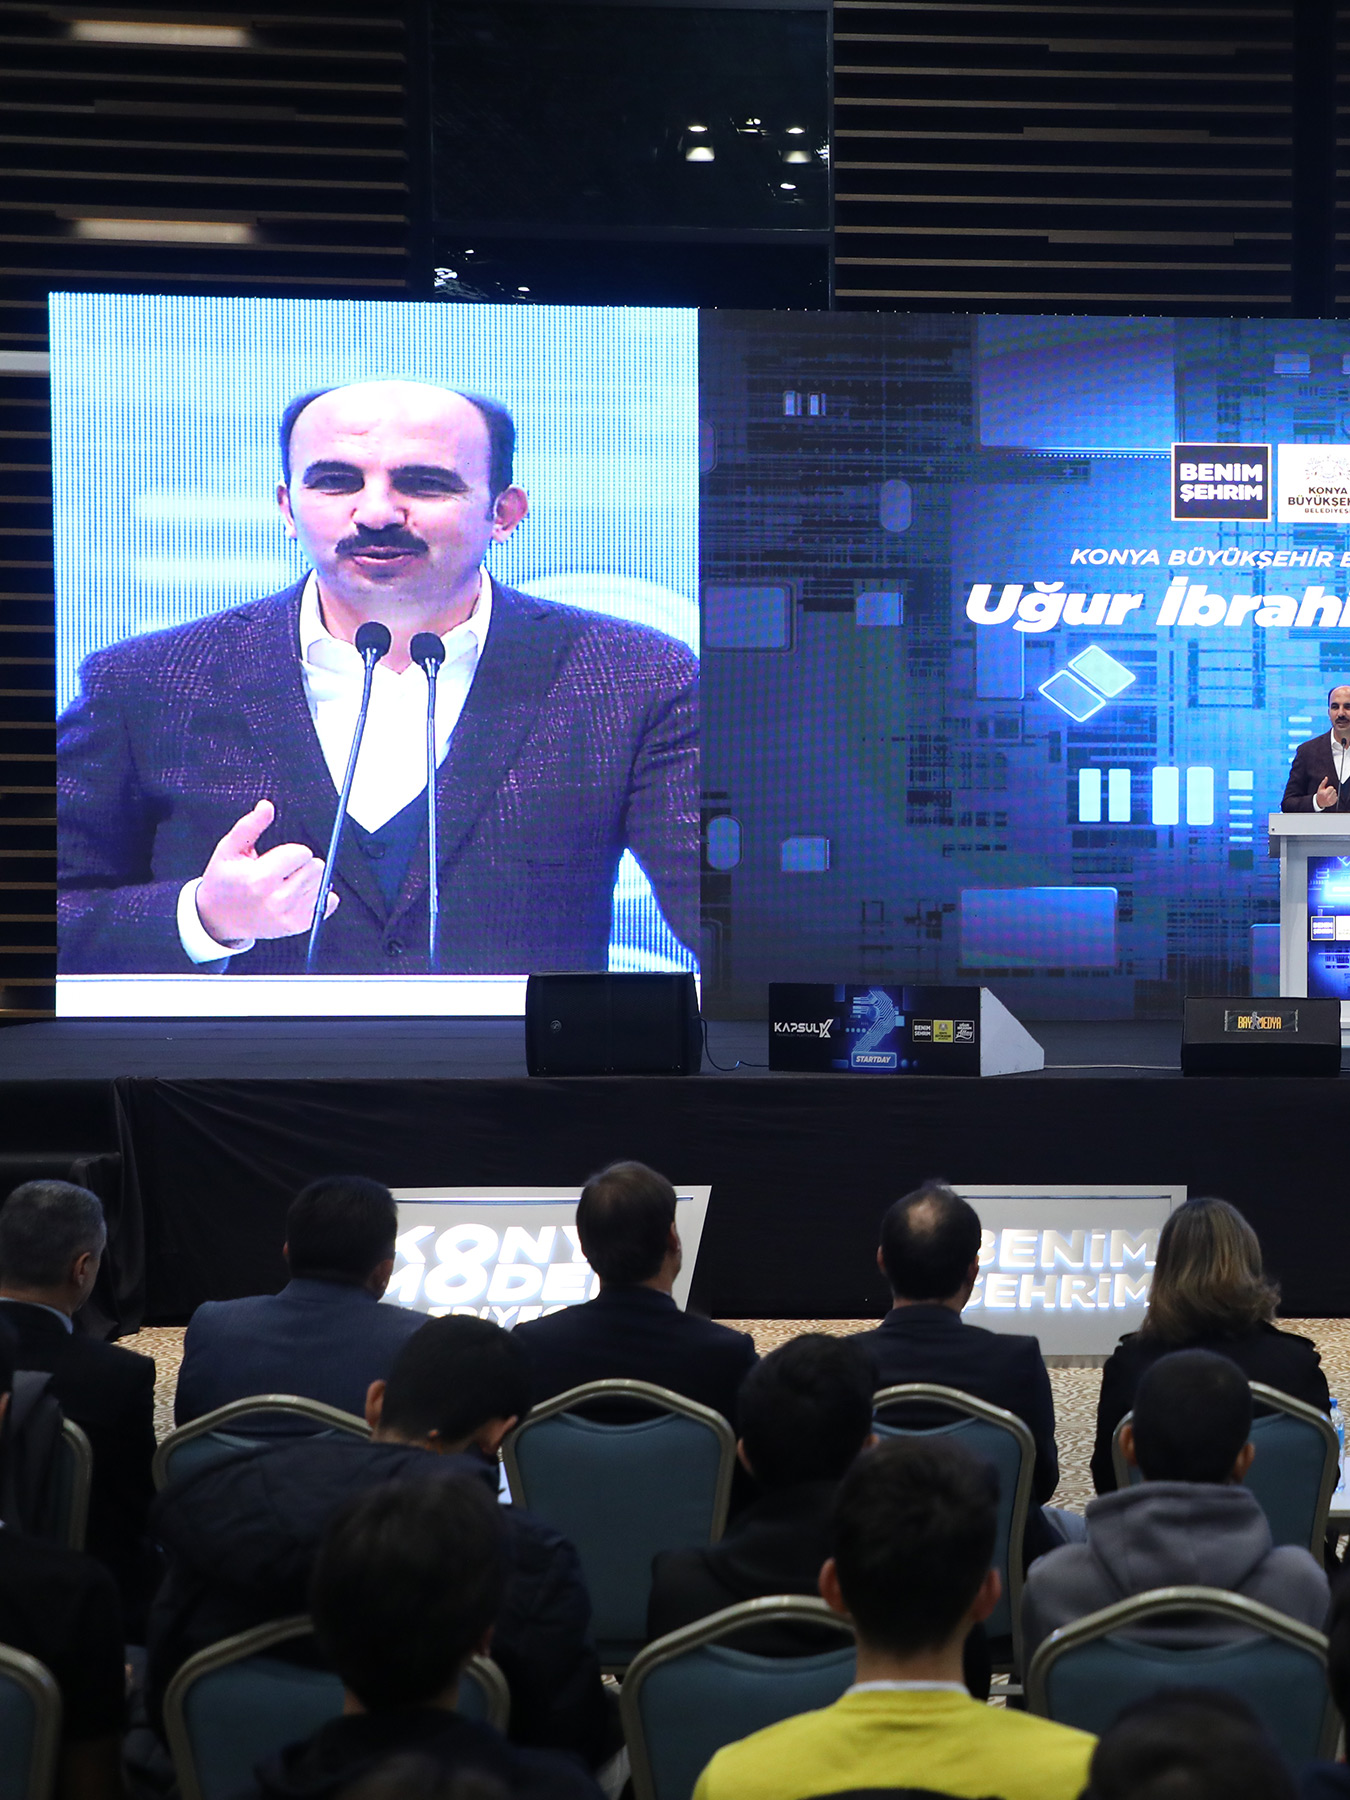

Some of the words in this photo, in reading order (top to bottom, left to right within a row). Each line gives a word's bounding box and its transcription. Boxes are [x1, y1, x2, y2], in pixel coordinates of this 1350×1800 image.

[1308, 487, 1348, 495] KONYA
[1070, 548, 1160, 565] KONYA
[1168, 547, 1334, 570] BÜYÜKŞEHİR
[965, 581, 1144, 633] Uğur
[856, 1055, 891, 1063] STARTDAY
